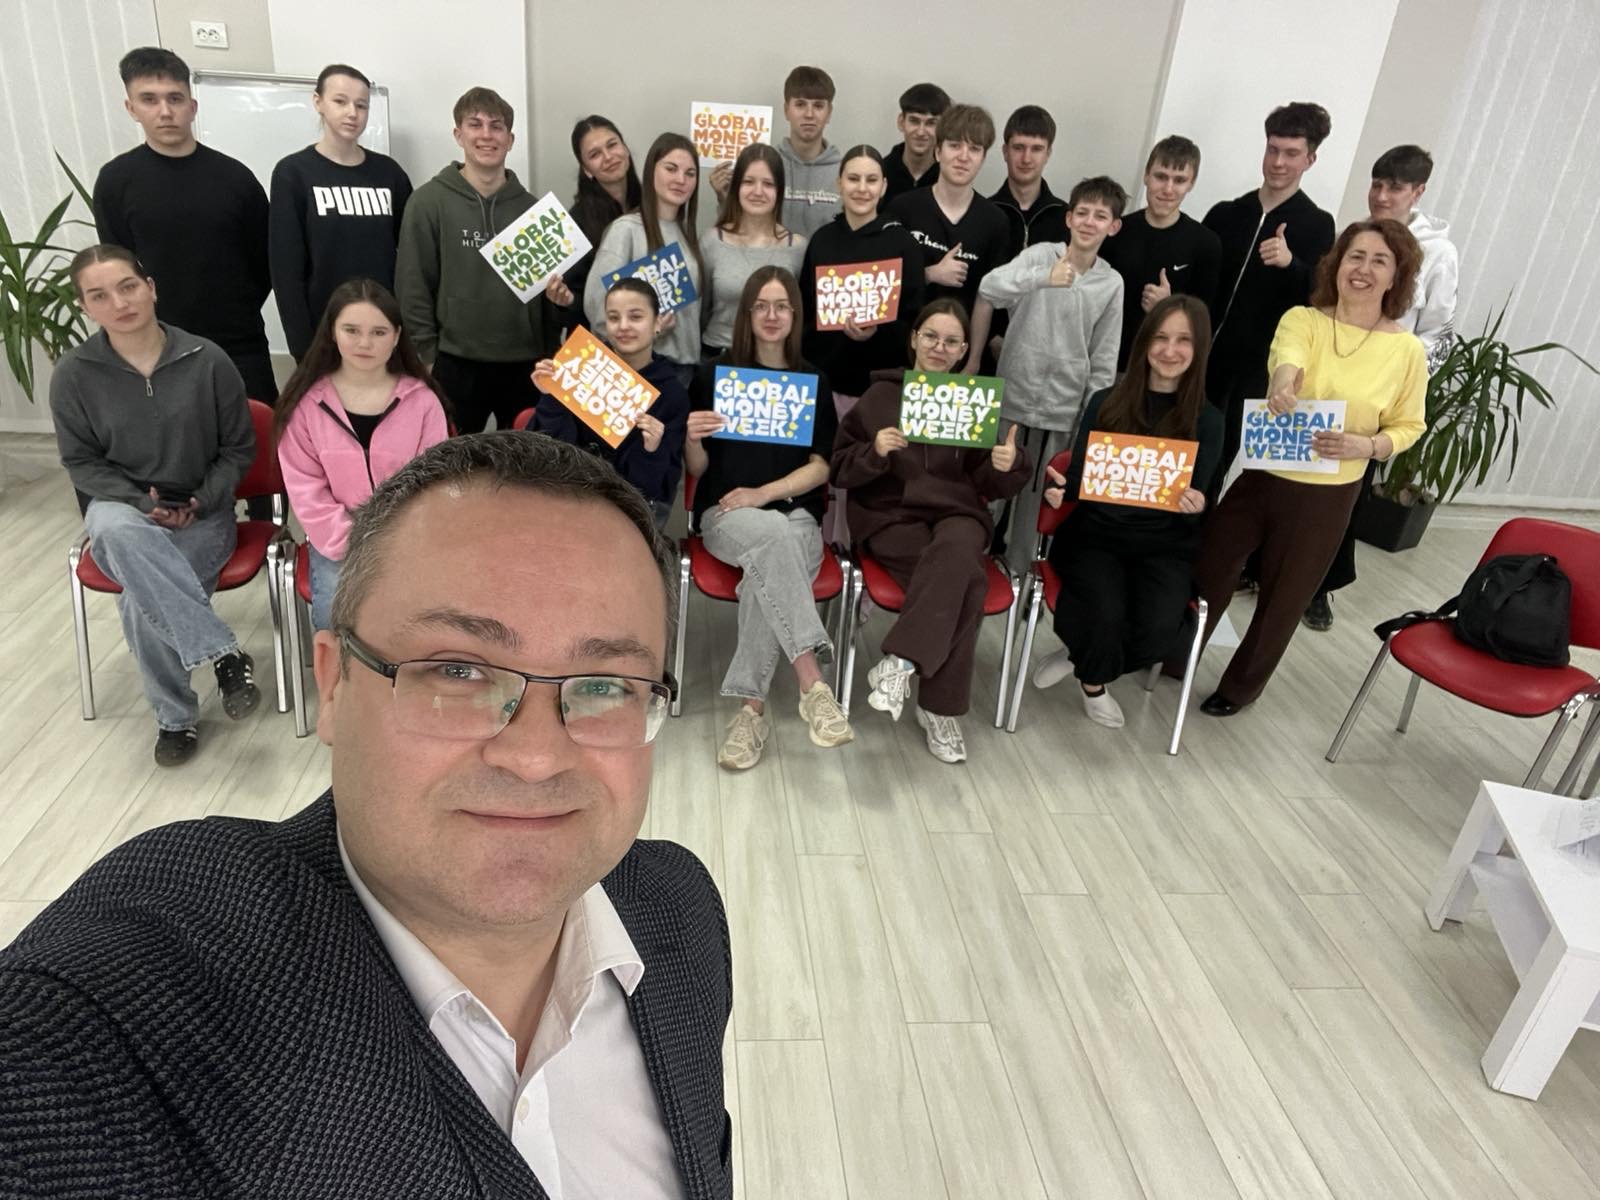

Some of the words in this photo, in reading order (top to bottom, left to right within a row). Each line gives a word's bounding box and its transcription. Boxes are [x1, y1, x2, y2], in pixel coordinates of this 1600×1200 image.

[694, 113, 769, 132] GLOBAL
[694, 129, 761, 145] MONEY
[696, 143, 741, 160] WEE
[312, 185, 393, 216] PUMA
[492, 207, 566, 267] GLOBAL
[501, 221, 565, 282] MONEY
[511, 244, 570, 292] WEEK
[817, 269, 901, 293] GLOBAL
[817, 286, 893, 309] MONEY
[817, 304, 880, 326] WEEK
[562, 357, 643, 421] MONEY
[586, 347, 652, 412] WEEK
[715, 378, 816, 406] GLOBAL
[552, 359, 630, 436] GLOBAL
[903, 382, 1001, 409] GLOBAL
[714, 397, 805, 422] MONEY
[902, 400, 991, 424] MONEY
[1246, 411, 1341, 430] GLOBAL
[900, 417, 974, 441] WEEK
[1244, 427, 1313, 445] MONE
[1087, 442, 1193, 473] GLOBAL
[1244, 443, 1313, 462] WEEK
[1084, 461, 1181, 488] MONEY
[1082, 477, 1161, 503] WEEK
